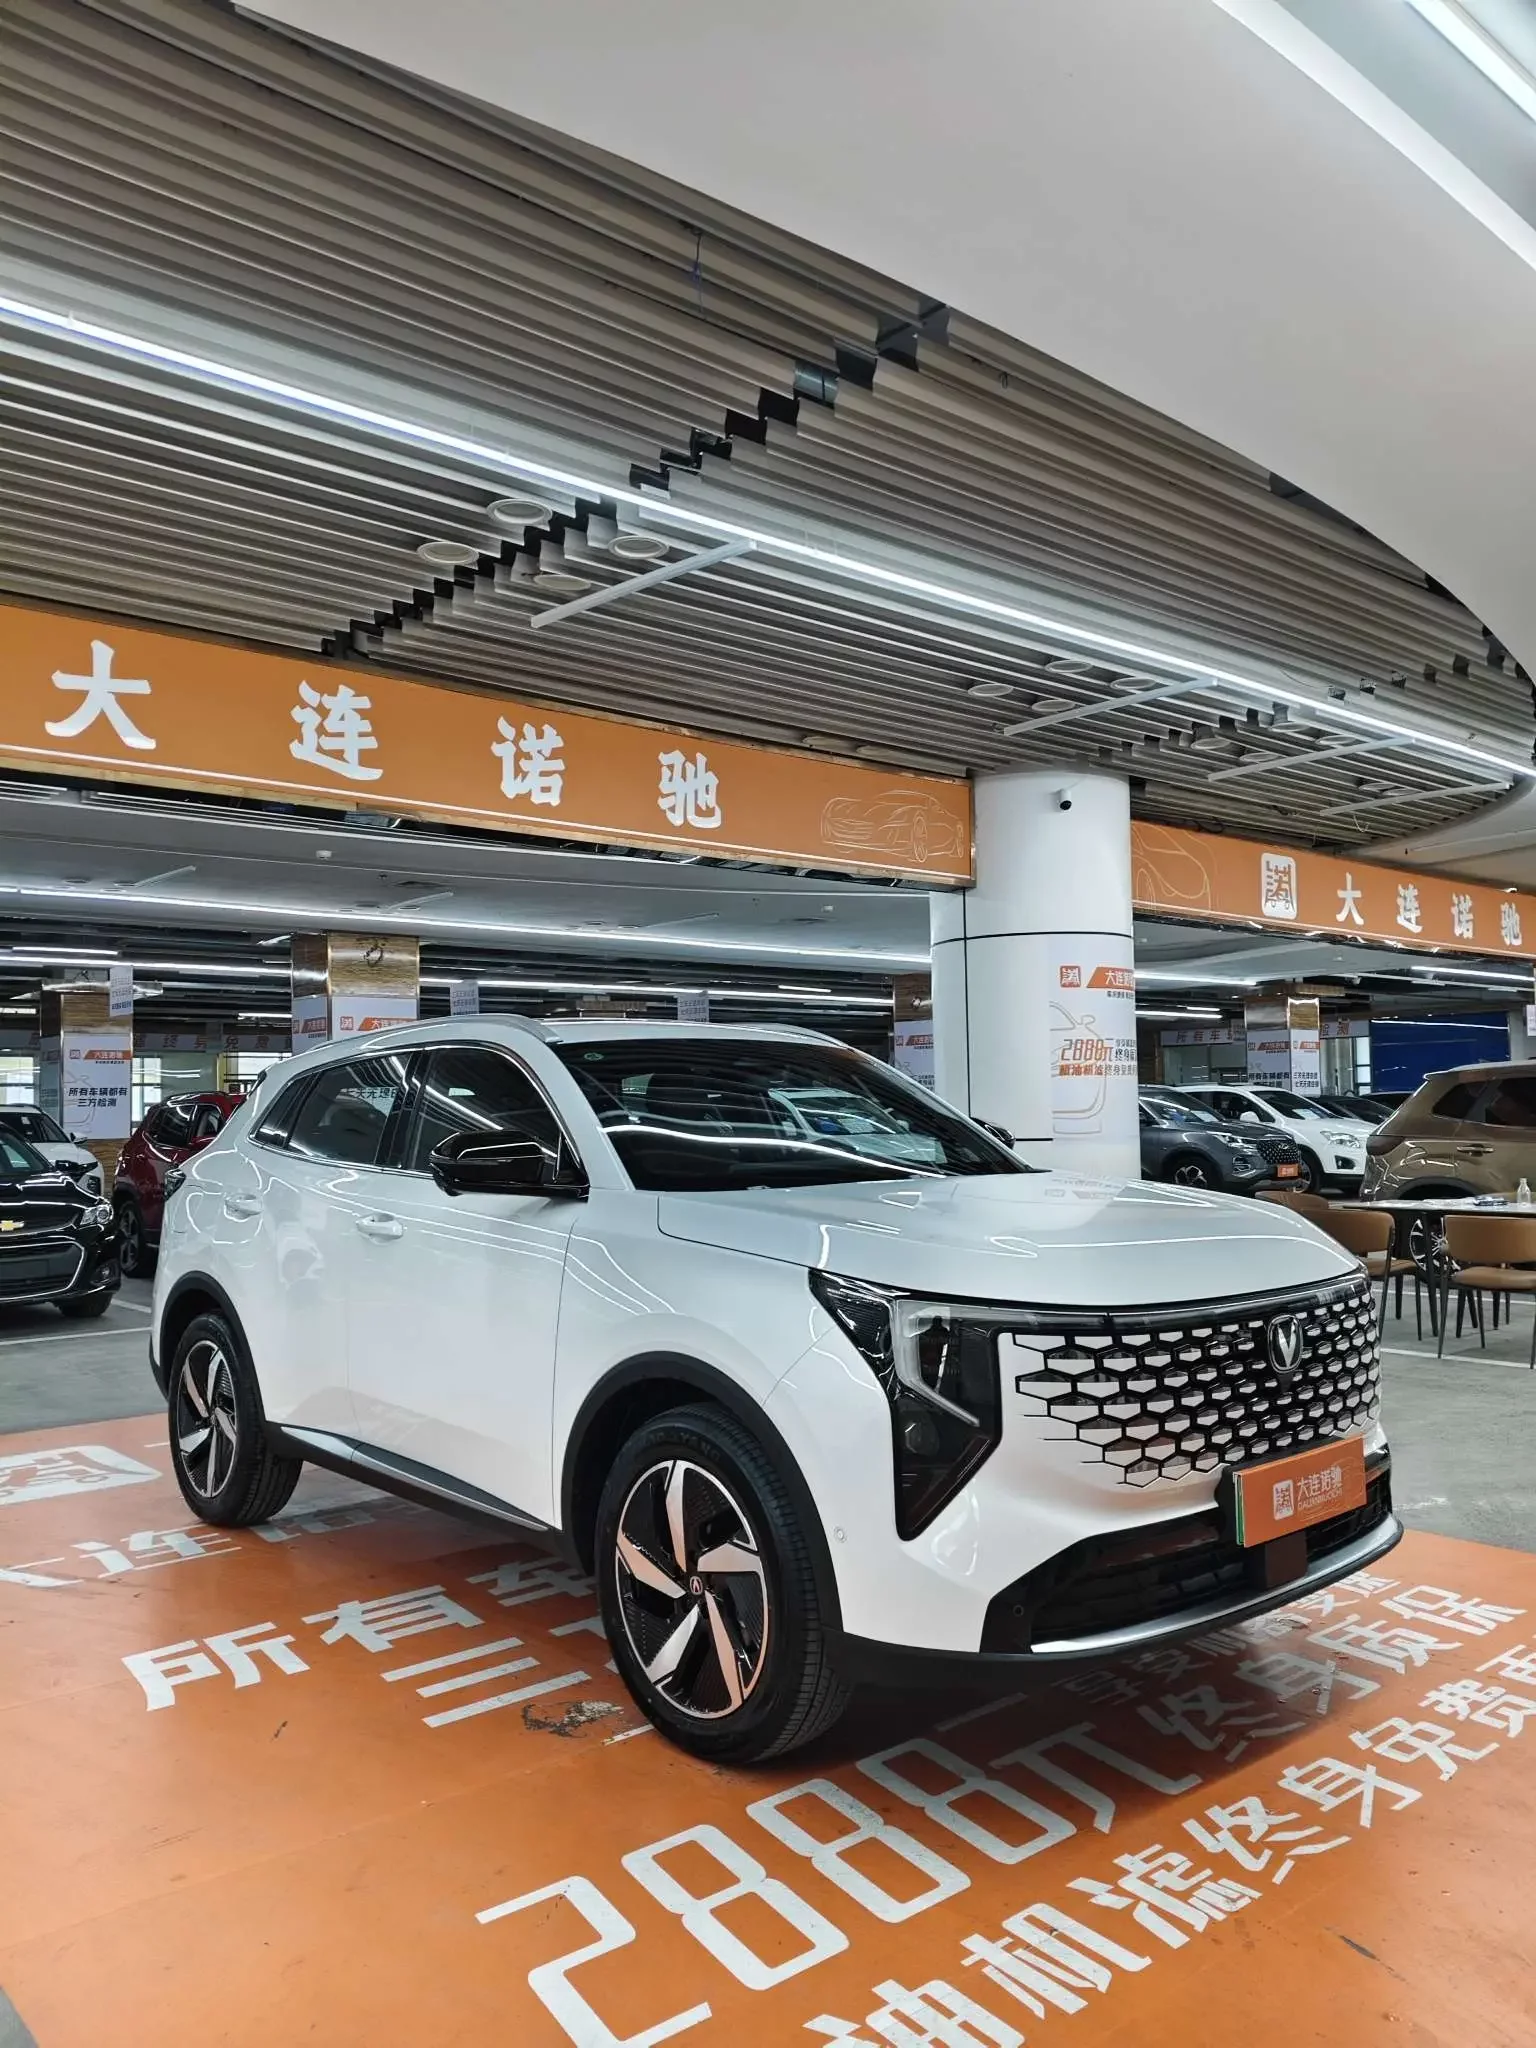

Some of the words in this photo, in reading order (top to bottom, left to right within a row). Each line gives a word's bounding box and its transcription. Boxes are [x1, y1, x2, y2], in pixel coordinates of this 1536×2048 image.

[45, 640, 722, 828] 大连诺驰
[1336, 871, 1523, 946] 大连诺驰
